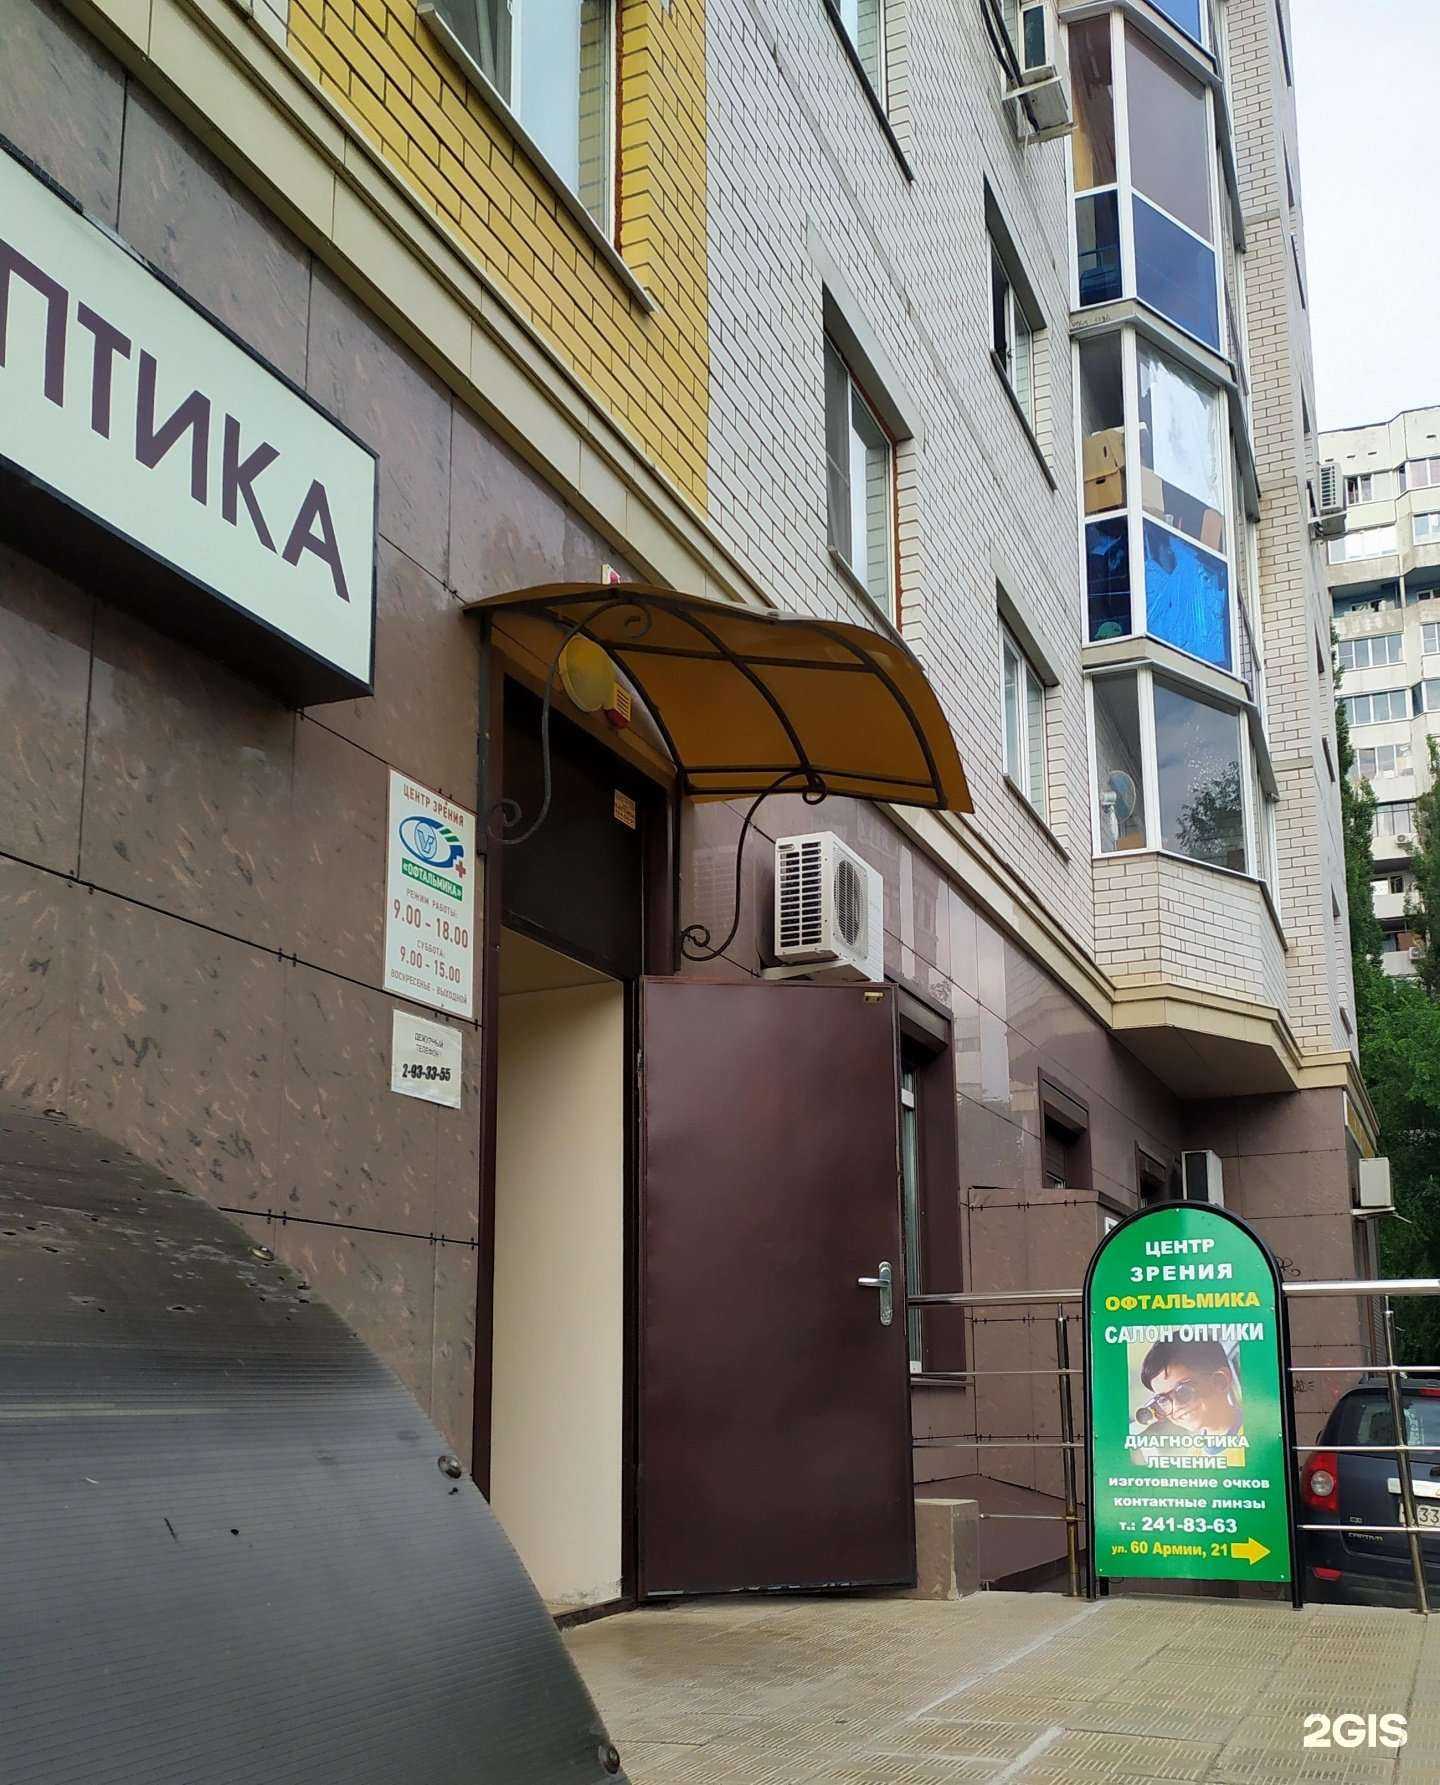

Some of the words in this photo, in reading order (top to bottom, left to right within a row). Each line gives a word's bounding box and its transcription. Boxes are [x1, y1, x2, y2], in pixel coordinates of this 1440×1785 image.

[403, 783, 430, 808] ЦЕНТР
[433, 800, 464, 827] ЗРЕНИЯ
[394, 899, 421, 928] 9.00
[436, 918, 468, 948] 18.00
[400, 945, 423, 969] 9.00
[434, 960, 461, 983] 15.00
[402, 1063, 451, 1081] 2-93-33-55
[1145, 1238, 1215, 1258] ЦЕНТР
[1130, 1263, 1232, 1282] ЗРЕНИЯ
[1105, 1291, 1261, 1311] ОФТАЛЬМИКА
[1104, 1324, 1174, 1344] САЛОН
[1179, 1322, 1264, 1342] ОПТИКИ
[1124, 1435, 1250, 1449] ДИАГНОСТИКА
[1147, 1455, 1227, 1469] ЛЕЧЕНИЕ
[1108, 1477, 1218, 1488] изготовление
[1222, 1478, 1270, 1489] очков
[1113, 1496, 1207, 1509] контактные
[1211, 1497, 1266, 1509] линзы
[1141, 1516, 1237, 1533] 241-83-63
[1111, 1544, 1127, 1556] ул.
[1130, 1541, 1148, 1554] 60
[1152, 1542, 1207, 1559] Армии,
[1210, 1543, 1228, 1557] 21
